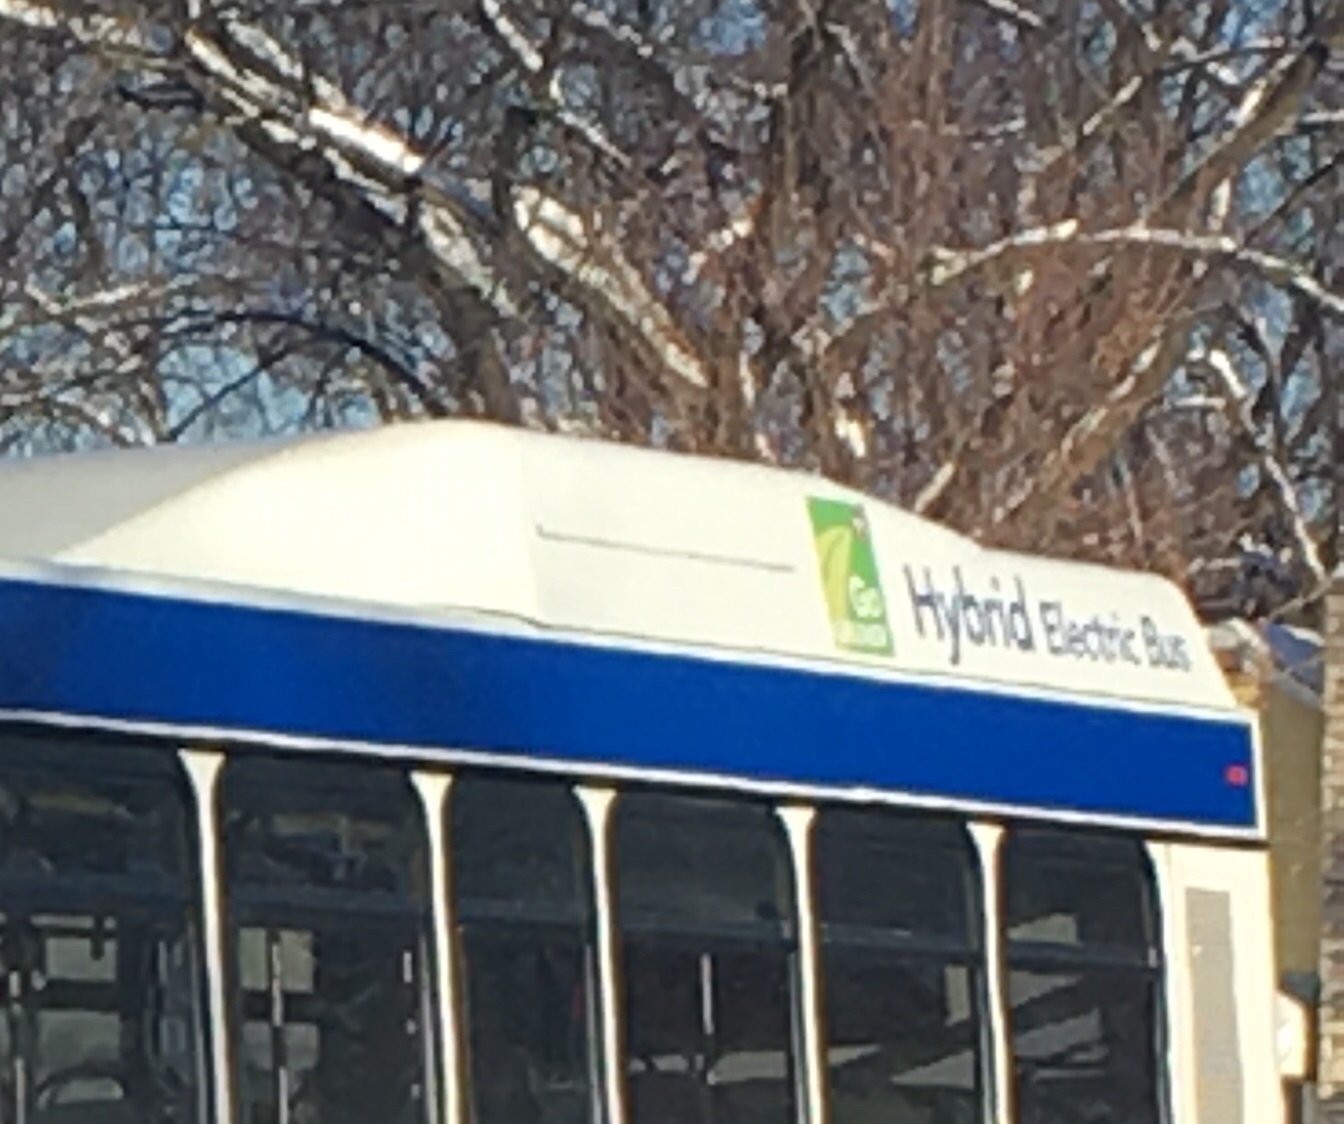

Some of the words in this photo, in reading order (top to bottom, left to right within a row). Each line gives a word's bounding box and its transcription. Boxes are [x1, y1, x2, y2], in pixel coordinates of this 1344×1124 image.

[904, 564, 1035, 666] Hybrid
[1041, 601, 1141, 668] Electric
[1144, 615, 1192, 672] Bus
